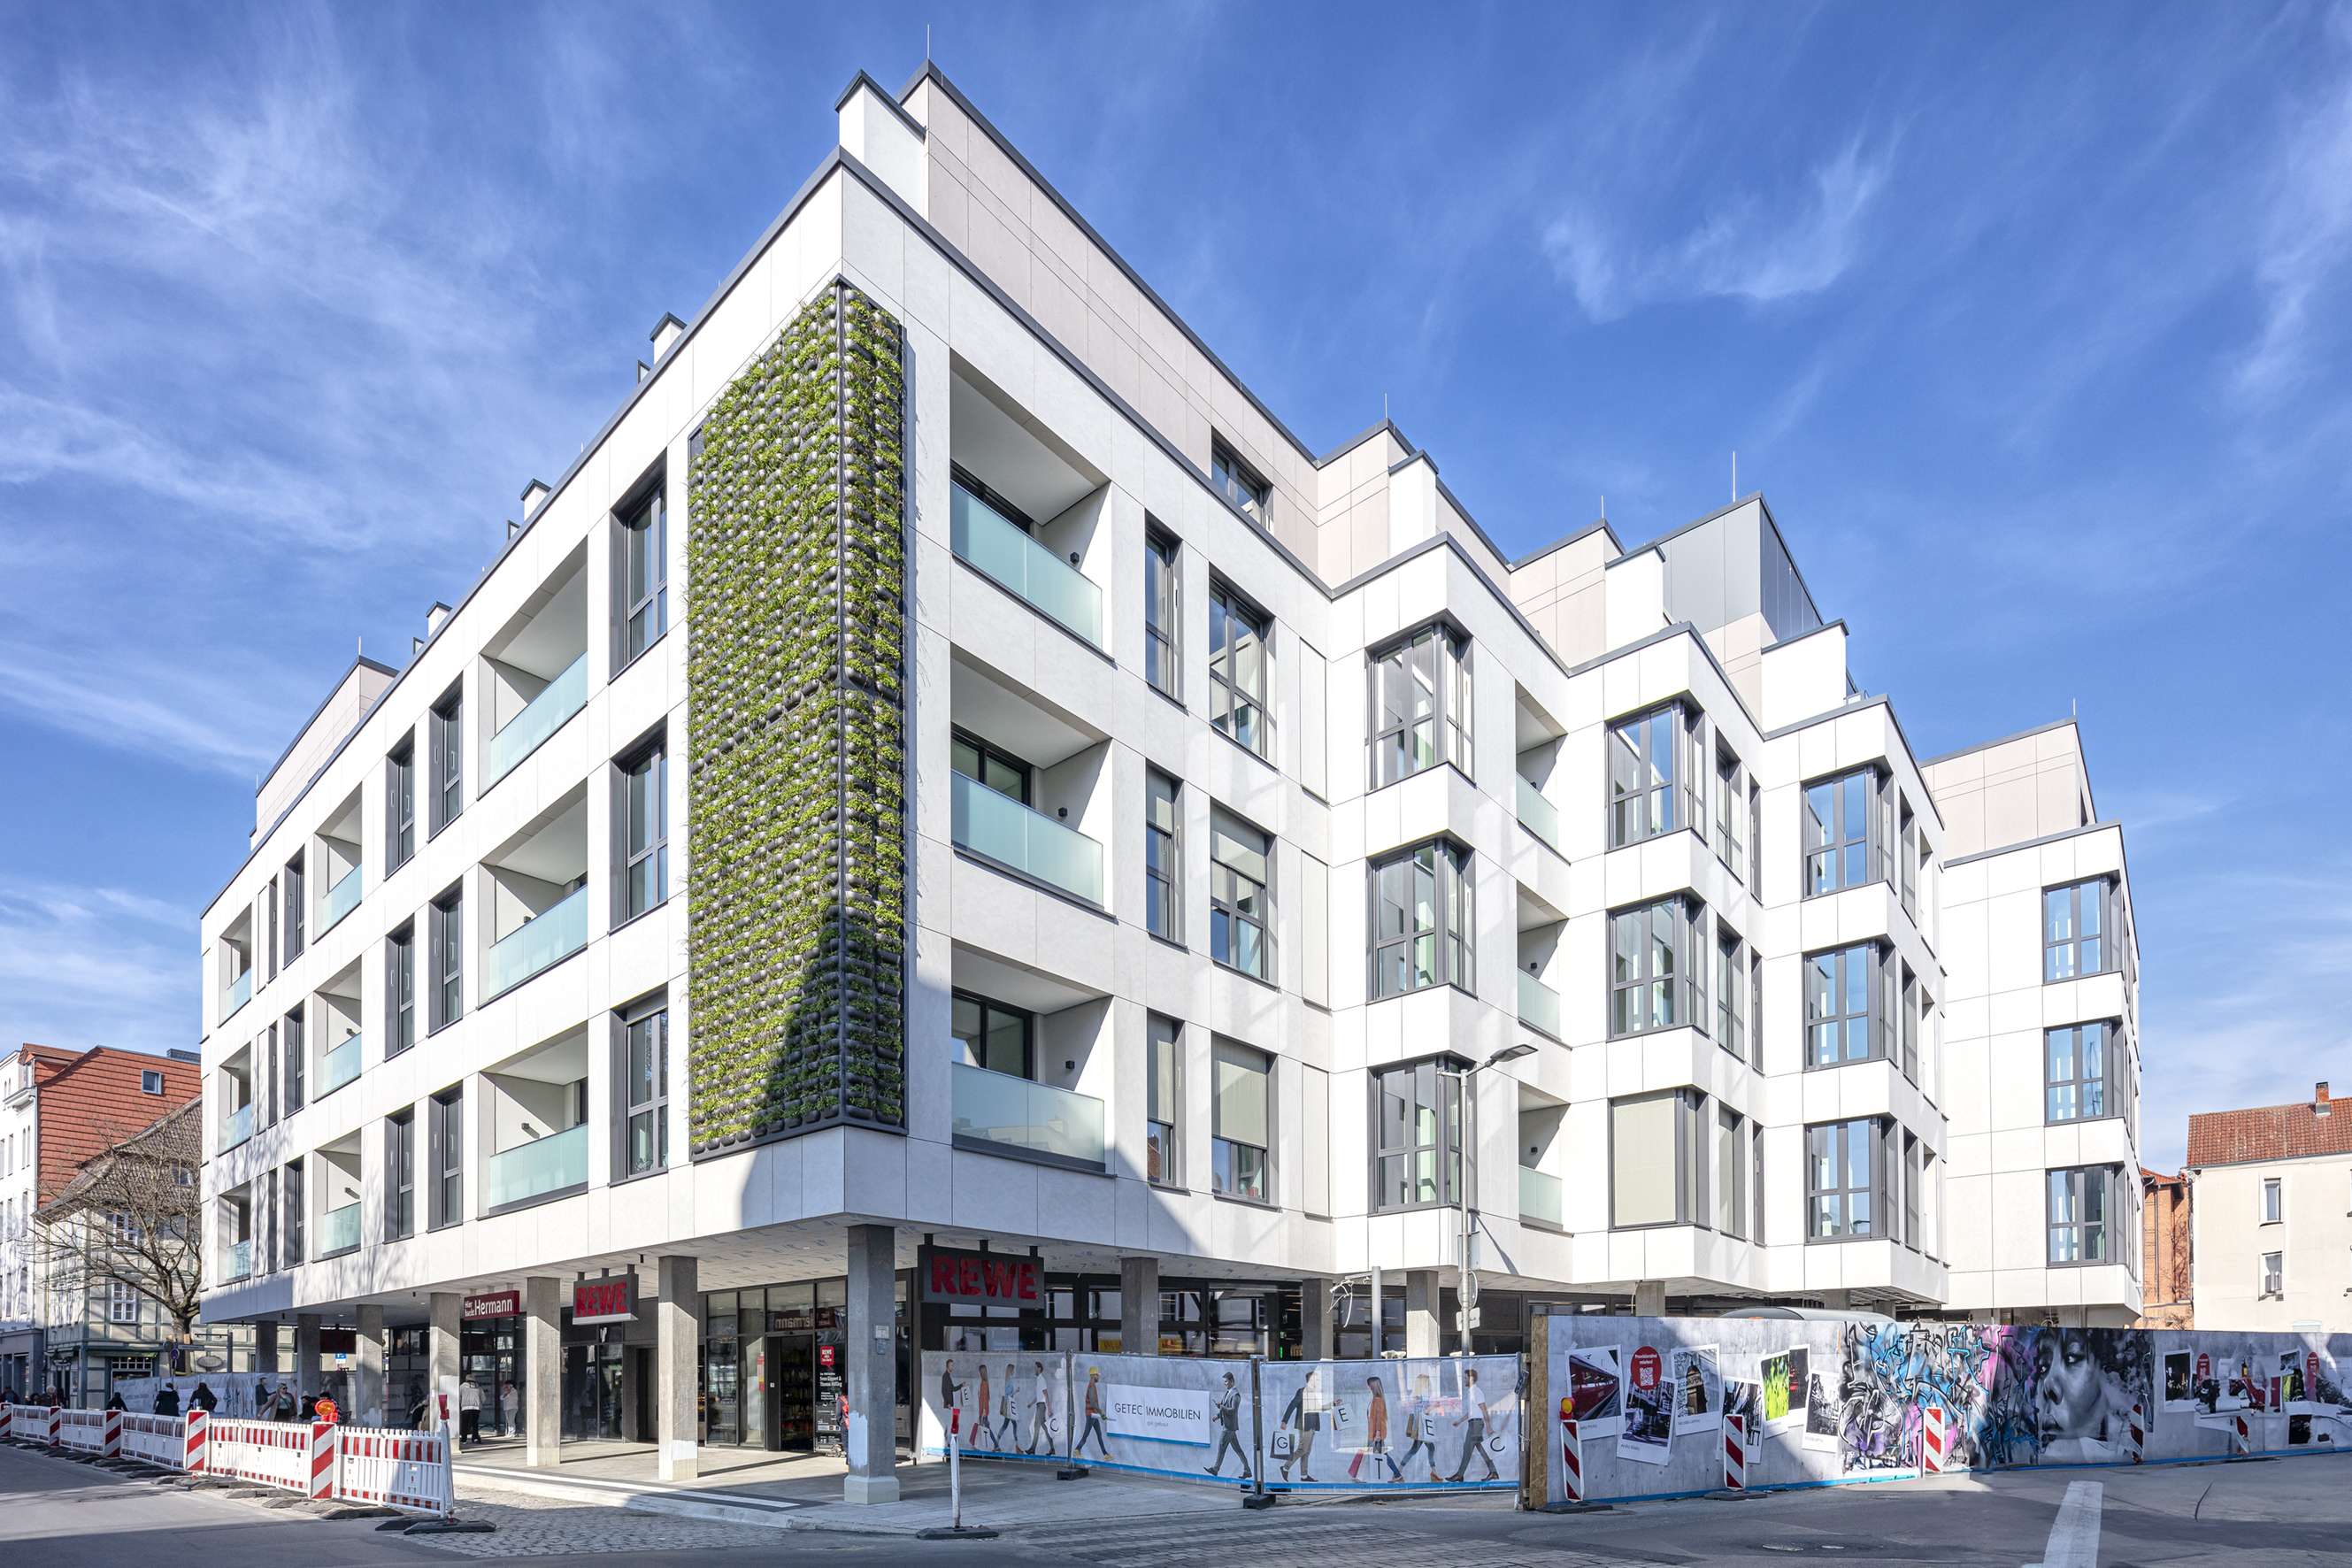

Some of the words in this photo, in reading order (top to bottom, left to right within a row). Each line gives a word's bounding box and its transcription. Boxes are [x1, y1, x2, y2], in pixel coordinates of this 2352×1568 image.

[931, 1256, 1037, 1300] REWE
[474, 1297, 513, 1316] Hermann
[576, 1283, 627, 1318] REWE
[1010, 1401, 1018, 1416] E
[1049, 1418, 1059, 1433] C
[1114, 1403, 1143, 1416] GETEC
[1146, 1406, 1201, 1420] IMMOBILIEN
[1276, 1436, 1289, 1449] G
[1339, 1408, 1349, 1423] E
[1374, 1457, 1384, 1480] T
[1425, 1418, 1435, 1437] E
[1489, 1436, 1506, 1453] C
